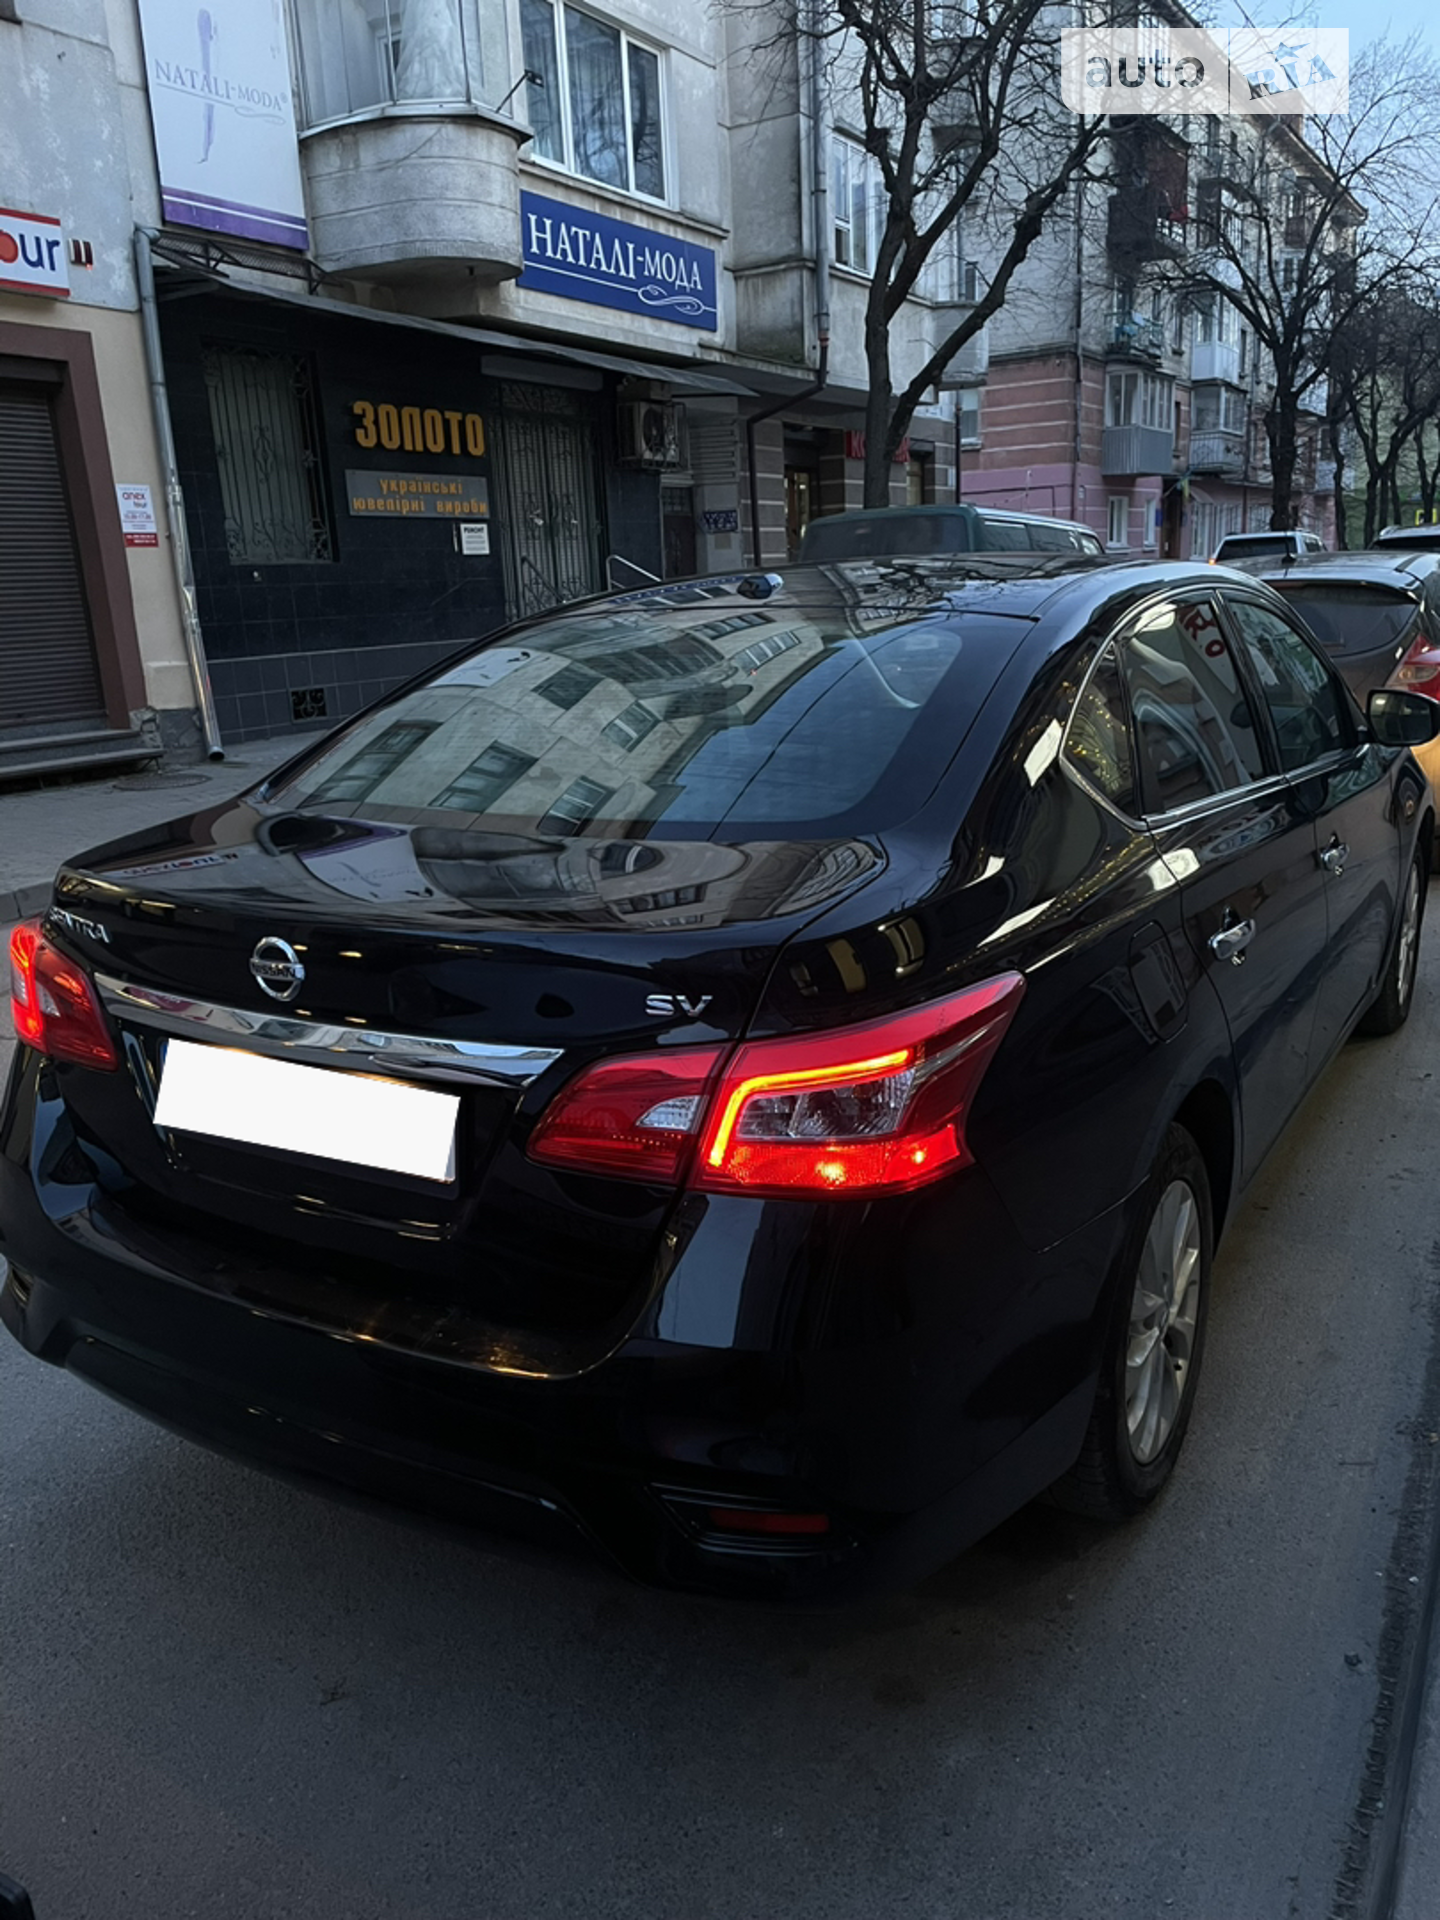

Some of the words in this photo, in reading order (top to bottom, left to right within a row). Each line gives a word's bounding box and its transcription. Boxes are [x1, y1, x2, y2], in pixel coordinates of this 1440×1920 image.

[527, 213, 703, 293] НАТАЛІ-МОДА
[353, 400, 485, 457] ЗОЛОТО
[645, 994, 713, 1017] SV
